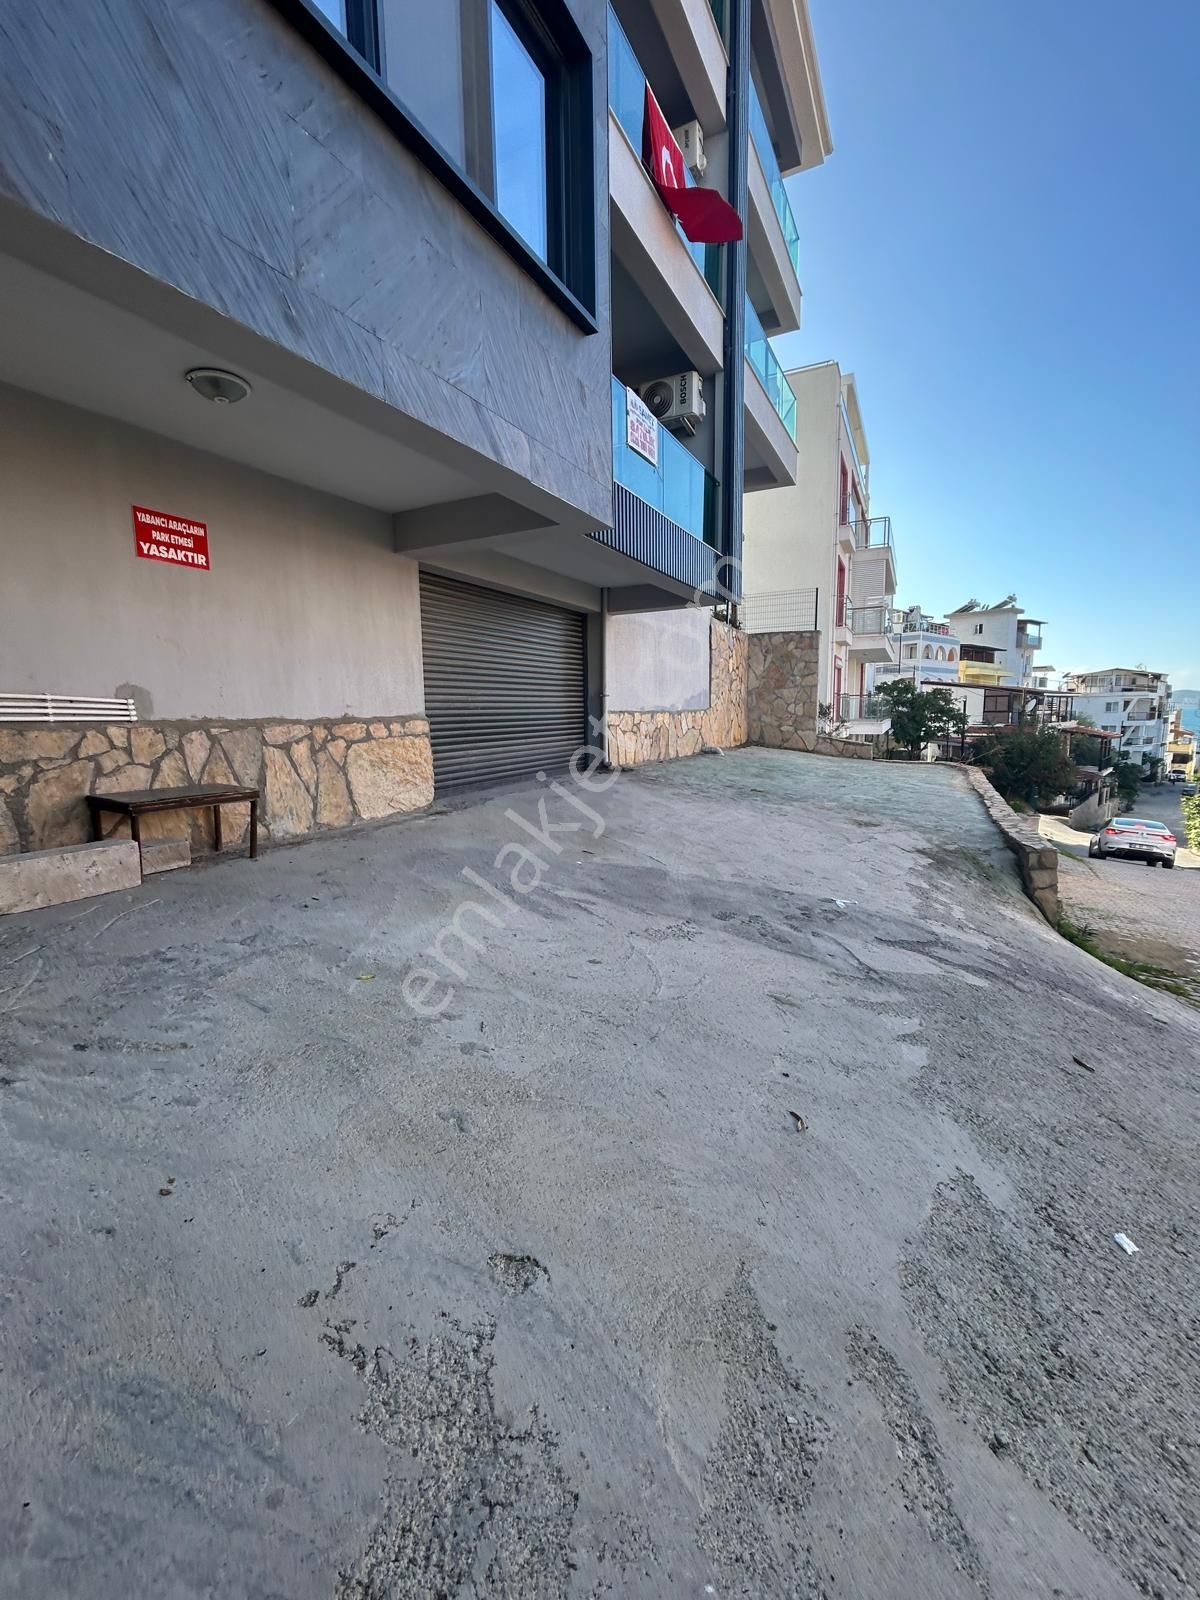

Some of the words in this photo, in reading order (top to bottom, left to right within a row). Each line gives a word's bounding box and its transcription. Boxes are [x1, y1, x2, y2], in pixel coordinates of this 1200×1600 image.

[136, 511, 168, 528] YABANCI
[168, 520, 205, 537] ARAÇLARIN
[151, 530, 170, 543] PARK
[171, 535, 194, 548] ETMESİ
[139, 541, 207, 566] YASAKTIR
